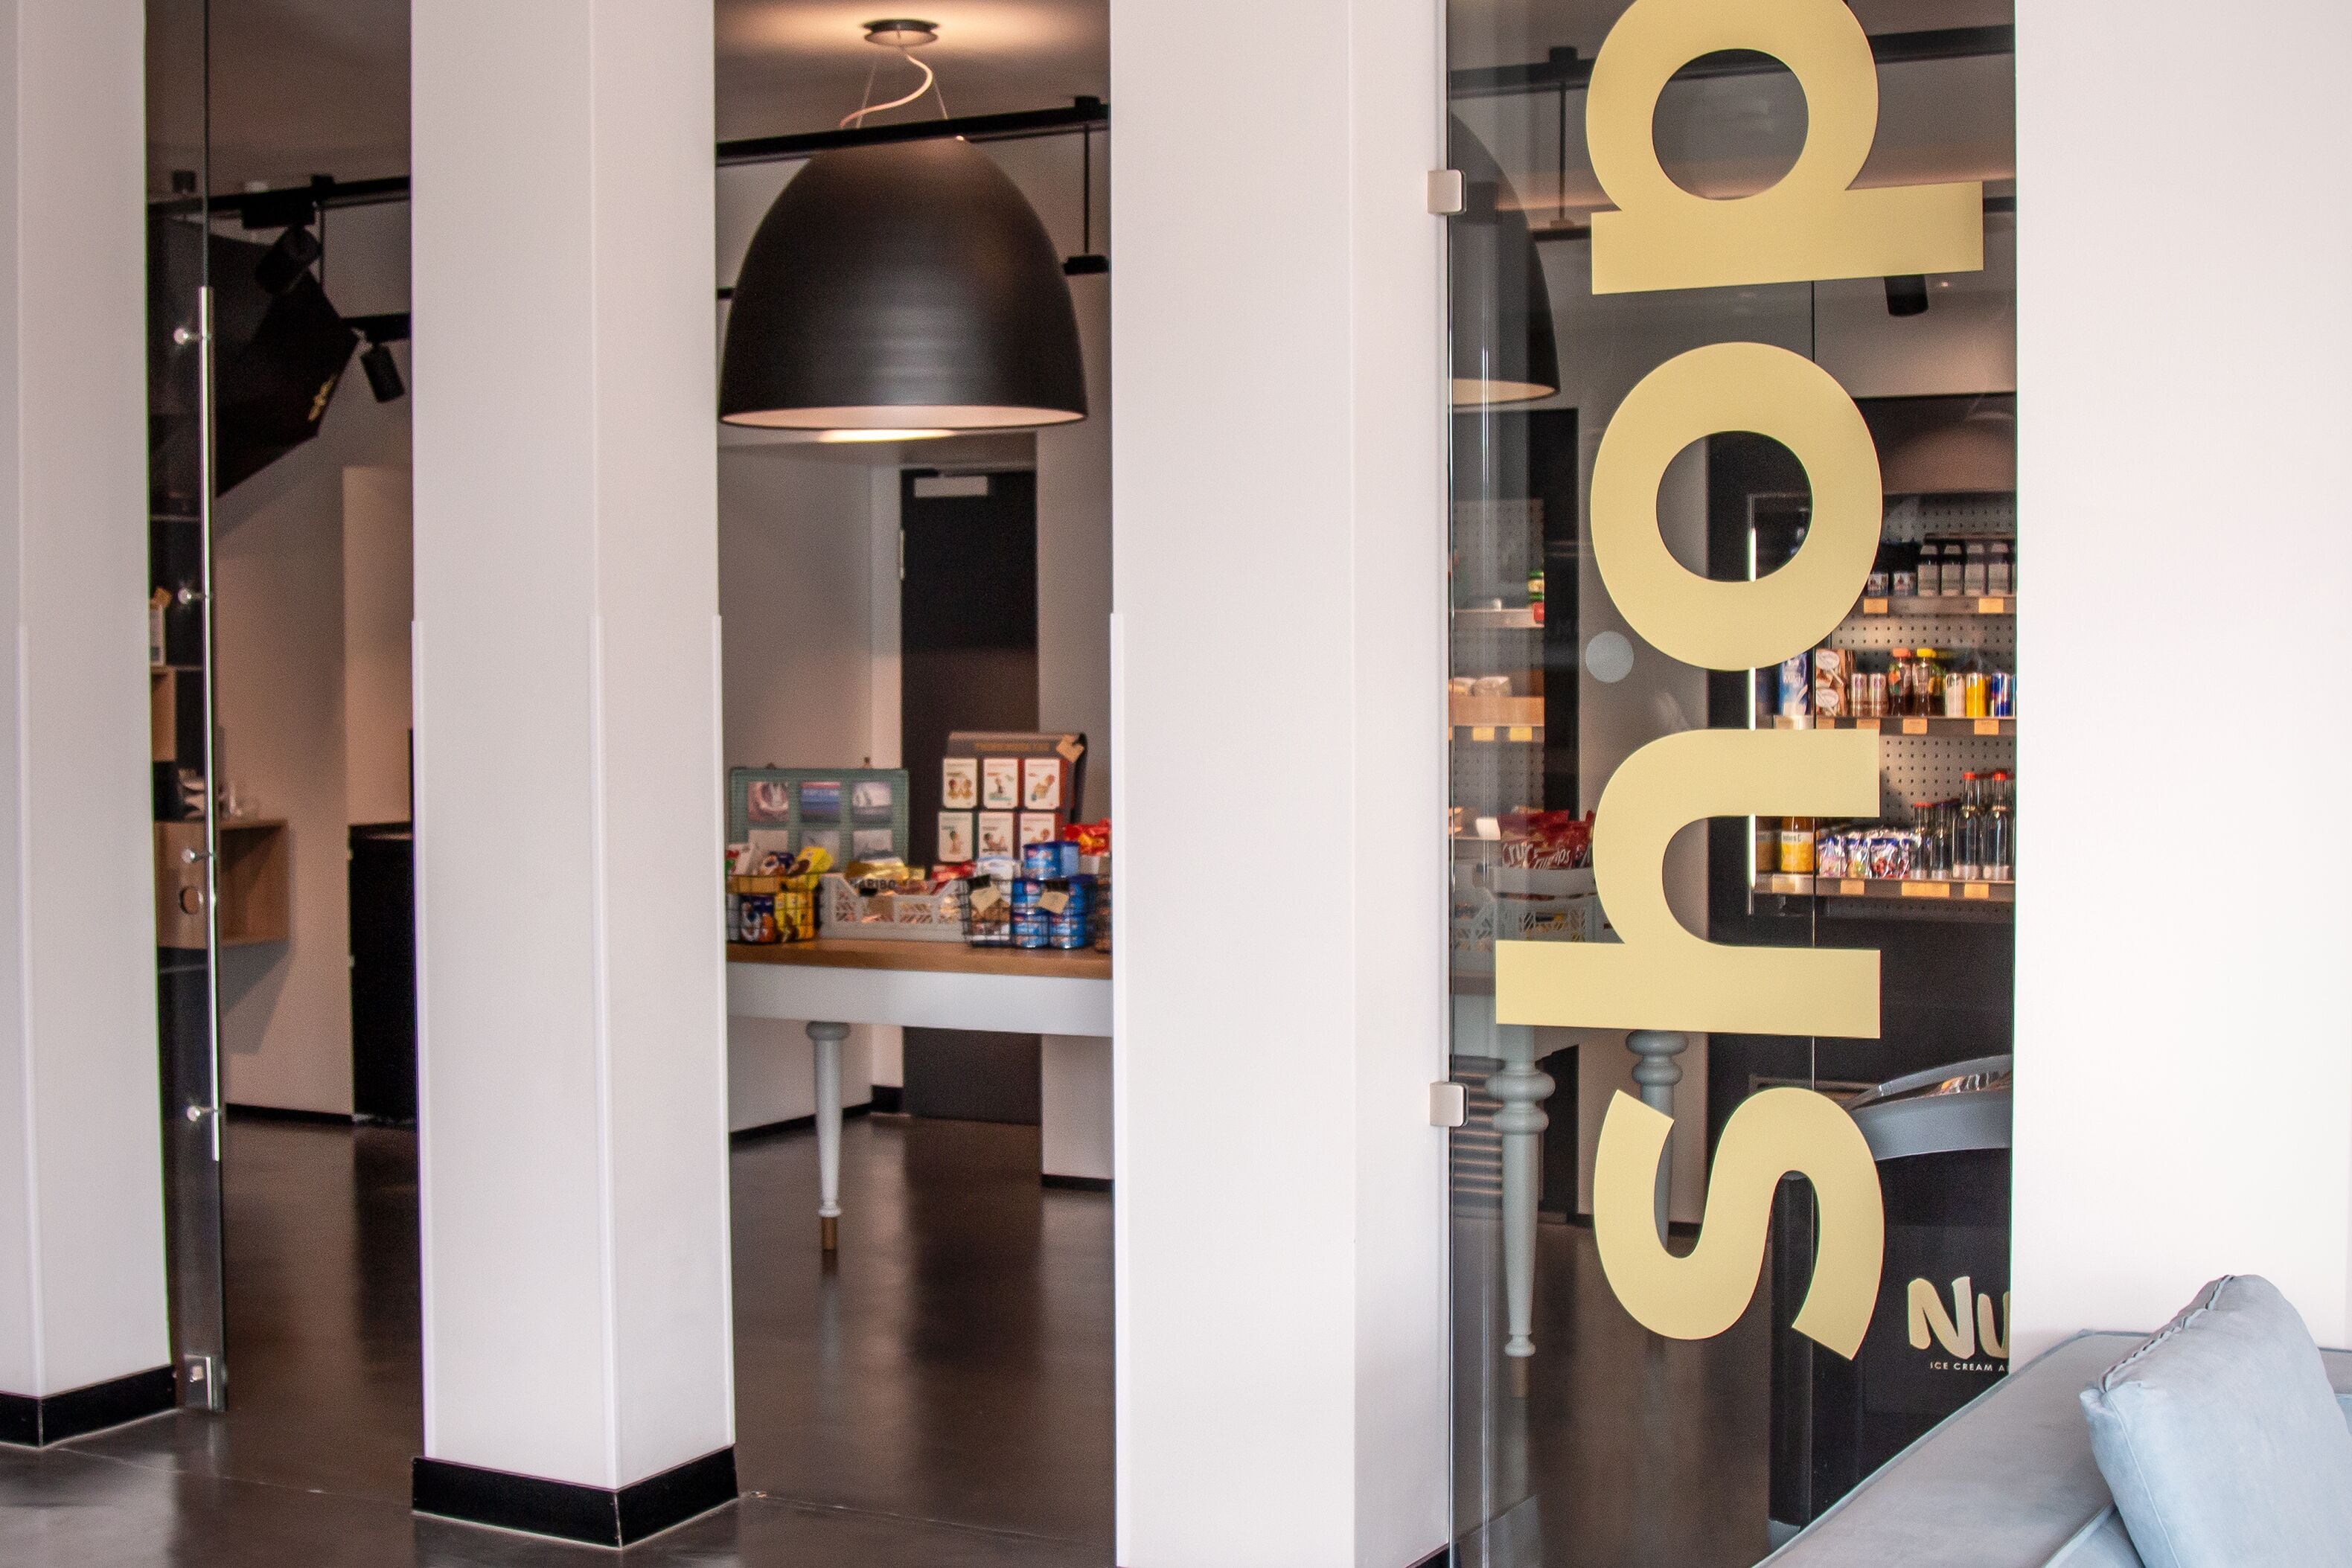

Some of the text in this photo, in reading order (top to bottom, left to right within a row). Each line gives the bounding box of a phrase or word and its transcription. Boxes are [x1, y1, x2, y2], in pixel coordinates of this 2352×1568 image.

[1495, 0, 1984, 1360] shop
[1929, 1361, 2010, 1372] ICE CREAM A
